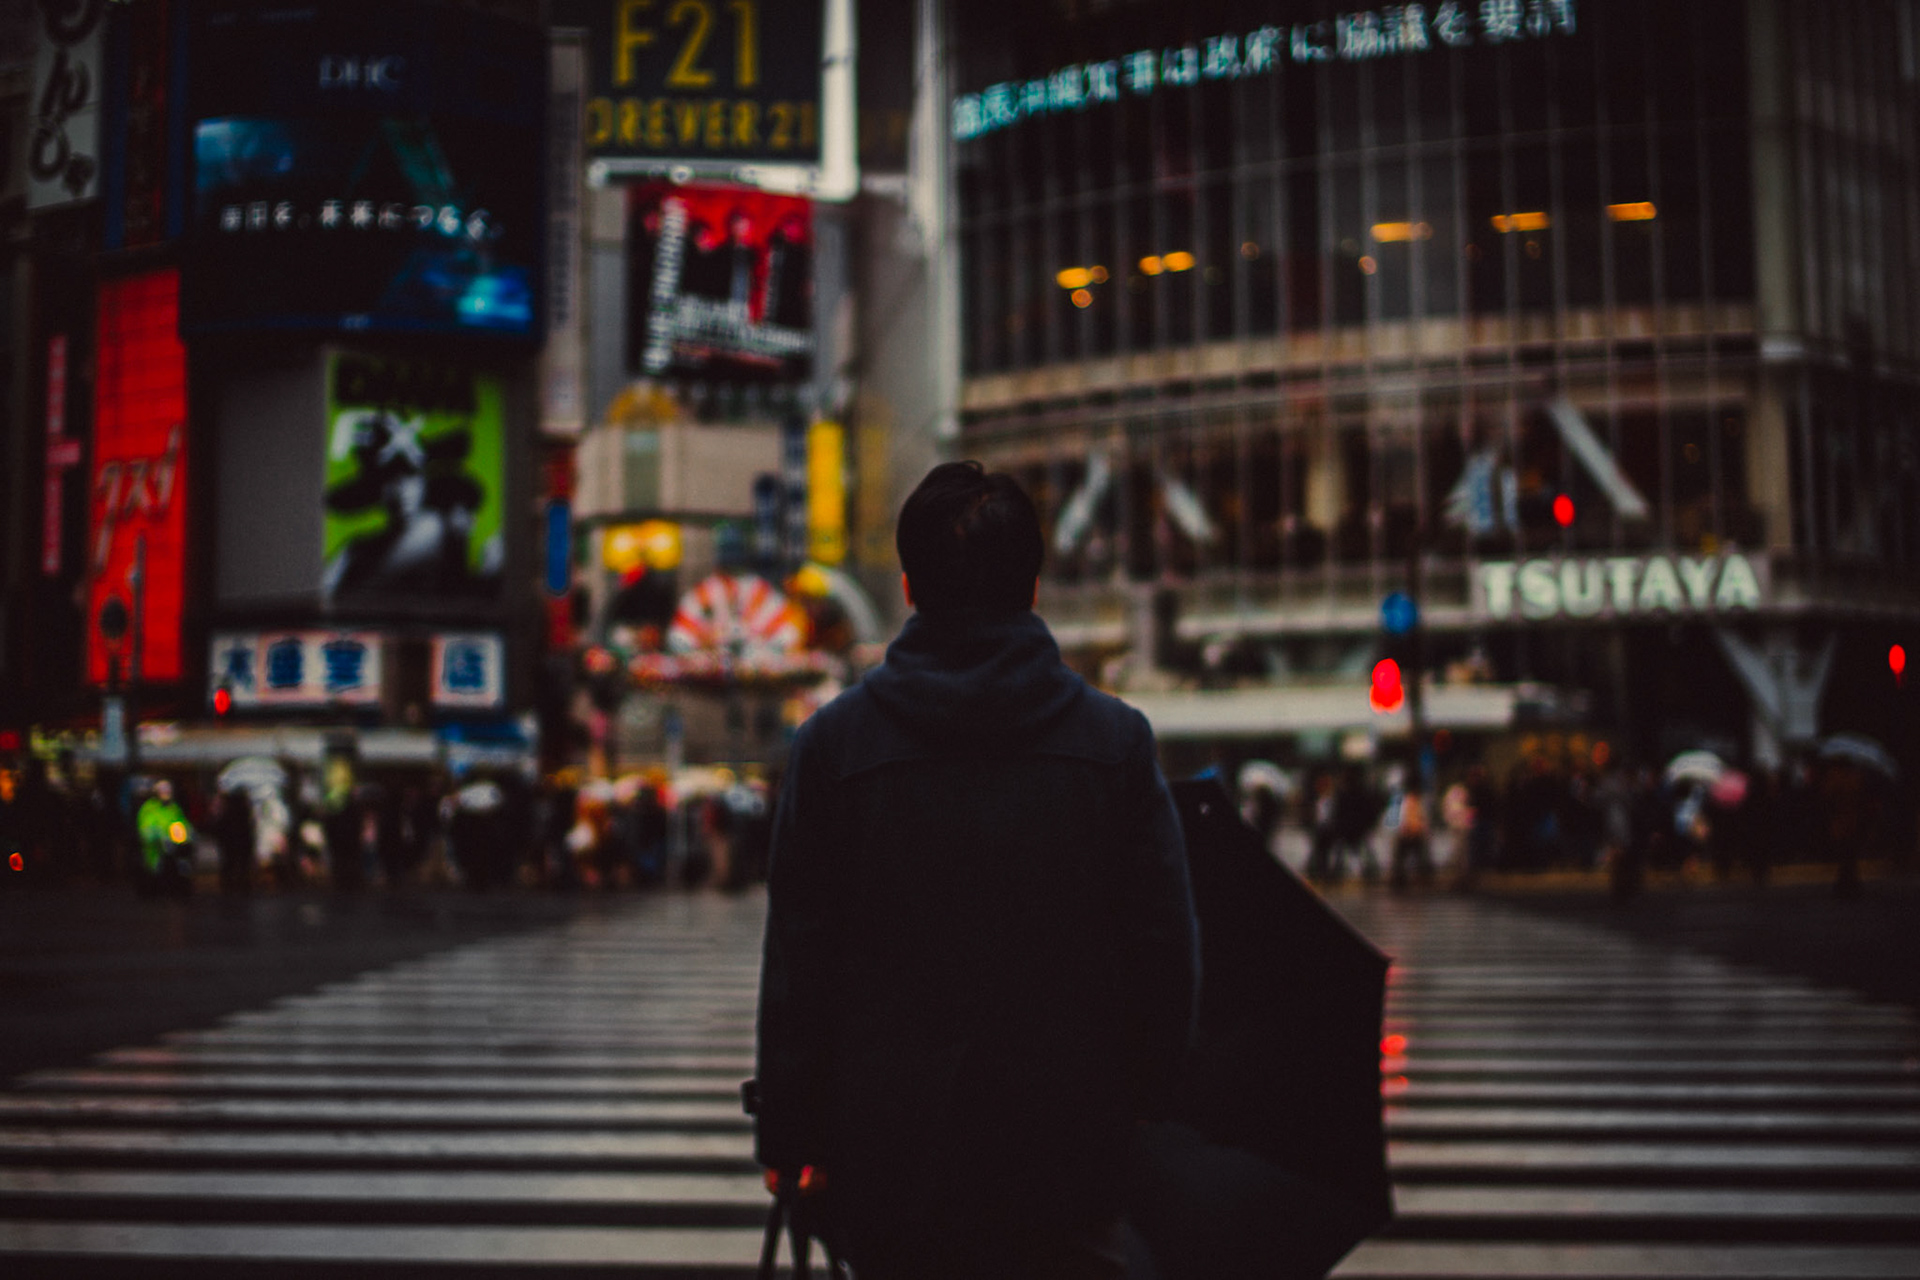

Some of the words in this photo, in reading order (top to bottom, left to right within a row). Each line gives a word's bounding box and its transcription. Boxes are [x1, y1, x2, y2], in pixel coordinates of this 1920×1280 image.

[614, 0, 757, 87] F21
[318, 54, 407, 94] DHC
[767, 101, 815, 148] 21
[1482, 555, 1761, 619] TSUTAYA
